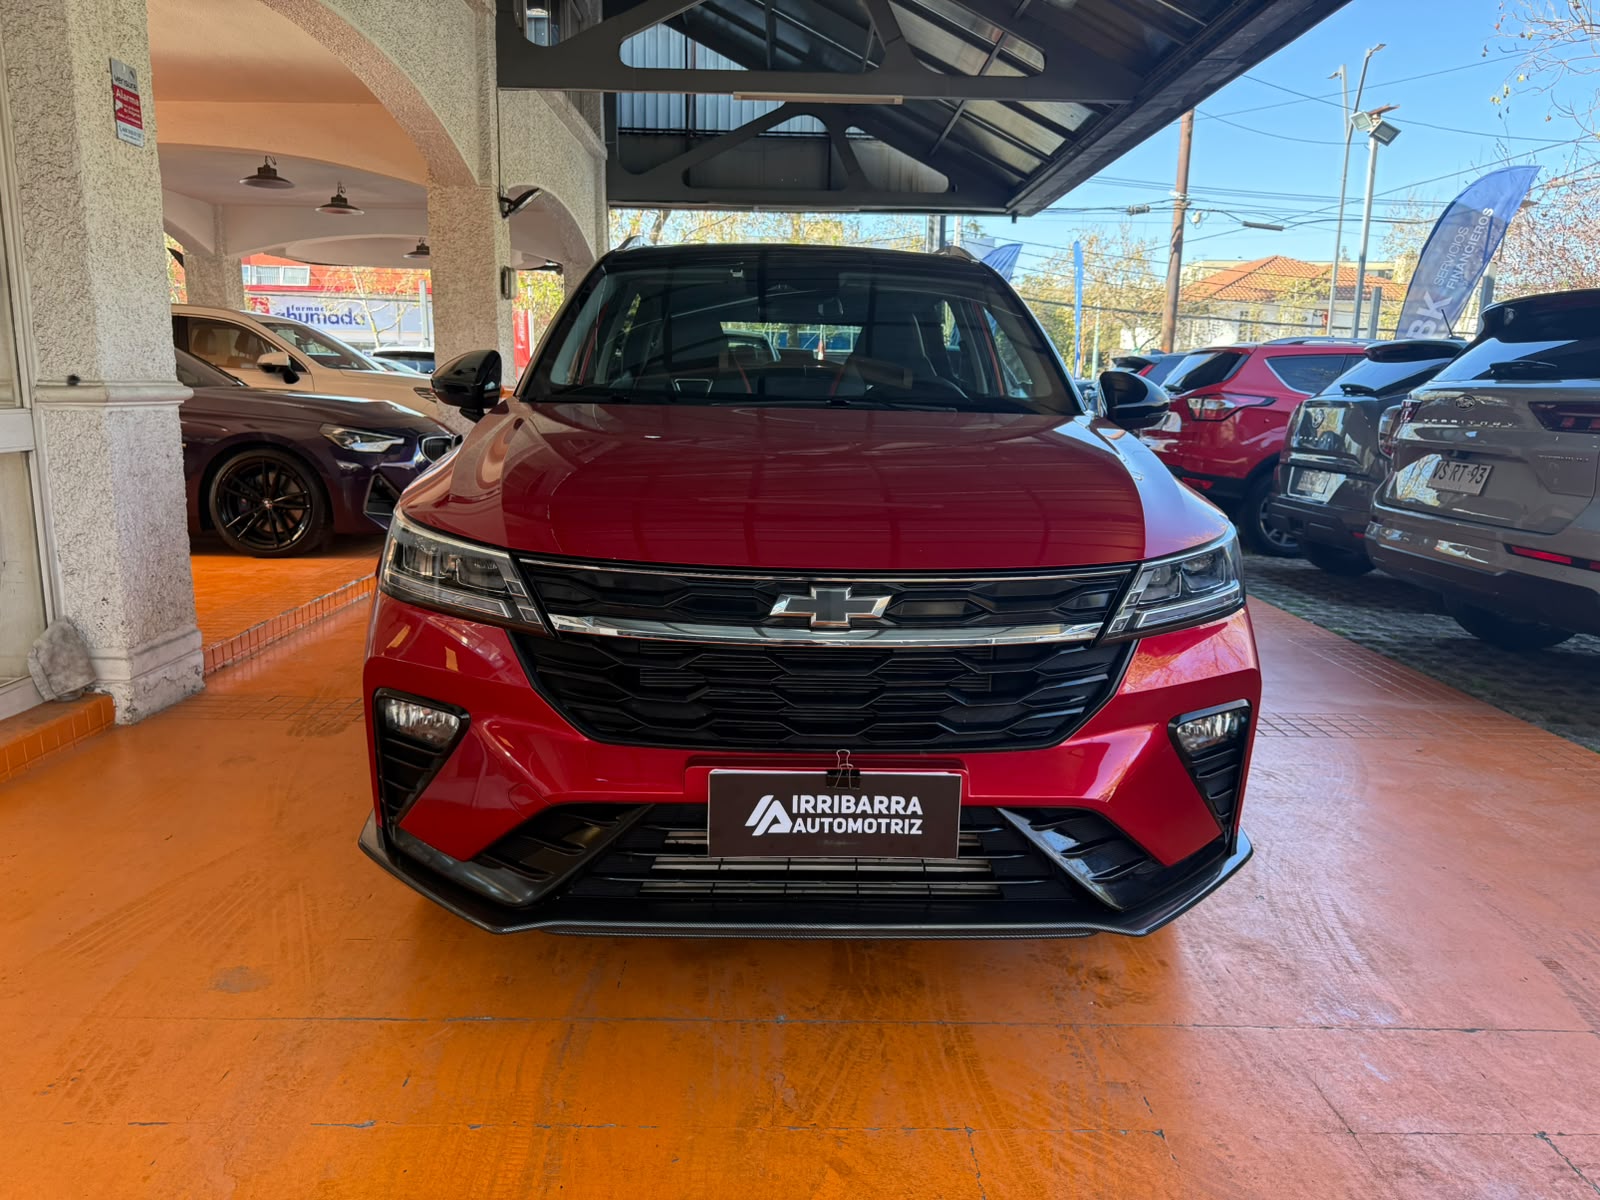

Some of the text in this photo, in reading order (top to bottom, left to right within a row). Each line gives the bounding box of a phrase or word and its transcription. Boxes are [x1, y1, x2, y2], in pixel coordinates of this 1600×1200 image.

[1434, 226, 1469, 286] SERVICIOS
[1447, 207, 1494, 289] FINANCIEROS
[1405, 291, 1453, 340] BK
[792, 794, 923, 815] IRRIBARRA
[792, 817, 923, 835] AUTOMOTRIZ
